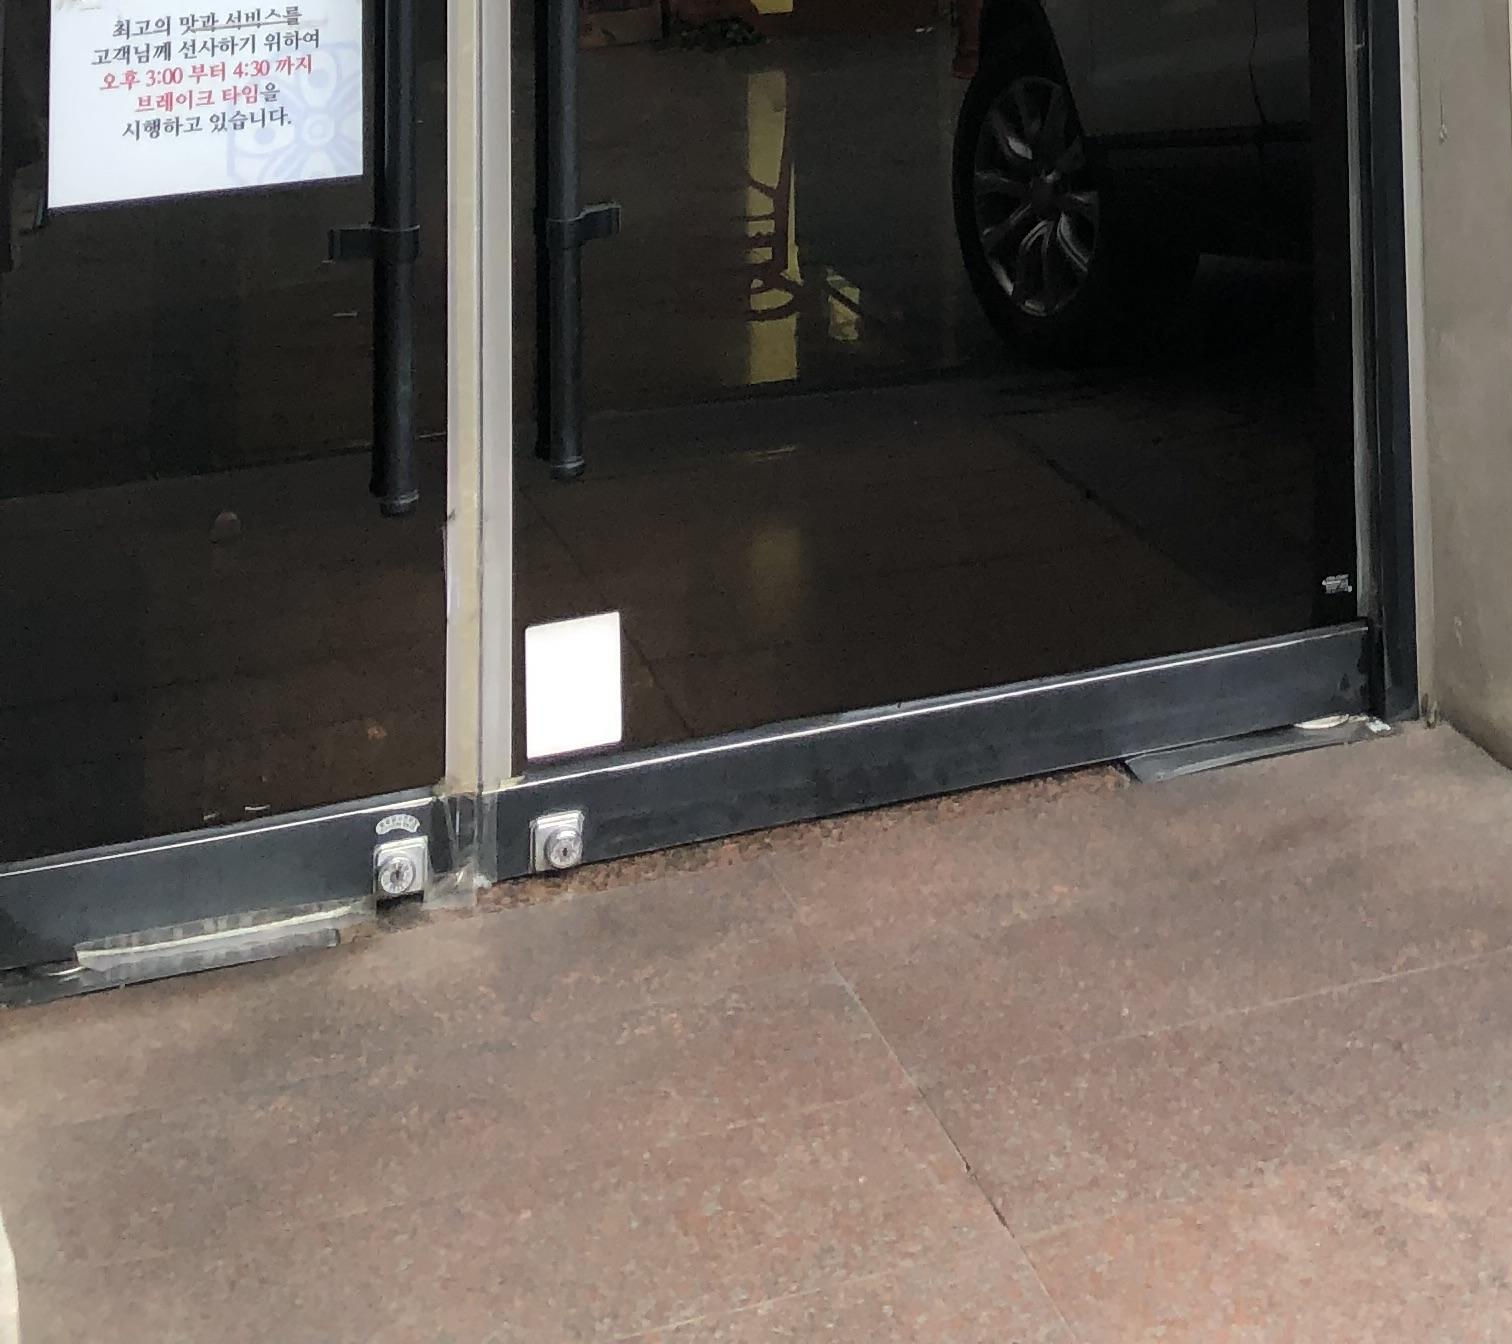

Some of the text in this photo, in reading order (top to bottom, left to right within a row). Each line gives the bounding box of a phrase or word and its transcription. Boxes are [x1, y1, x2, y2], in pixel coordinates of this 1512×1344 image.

[112, 14, 172, 40] 최고의
[178, 11, 219, 34] 맛과
[90, 28, 321, 66] 고객님께 선사하기 위하여
[99, 53, 313, 91] 오후 3:00 부터 4:30 까지
[134, 90, 215, 113] 브레이크
[121, 105, 292, 142] 시행하고 있습니다.
